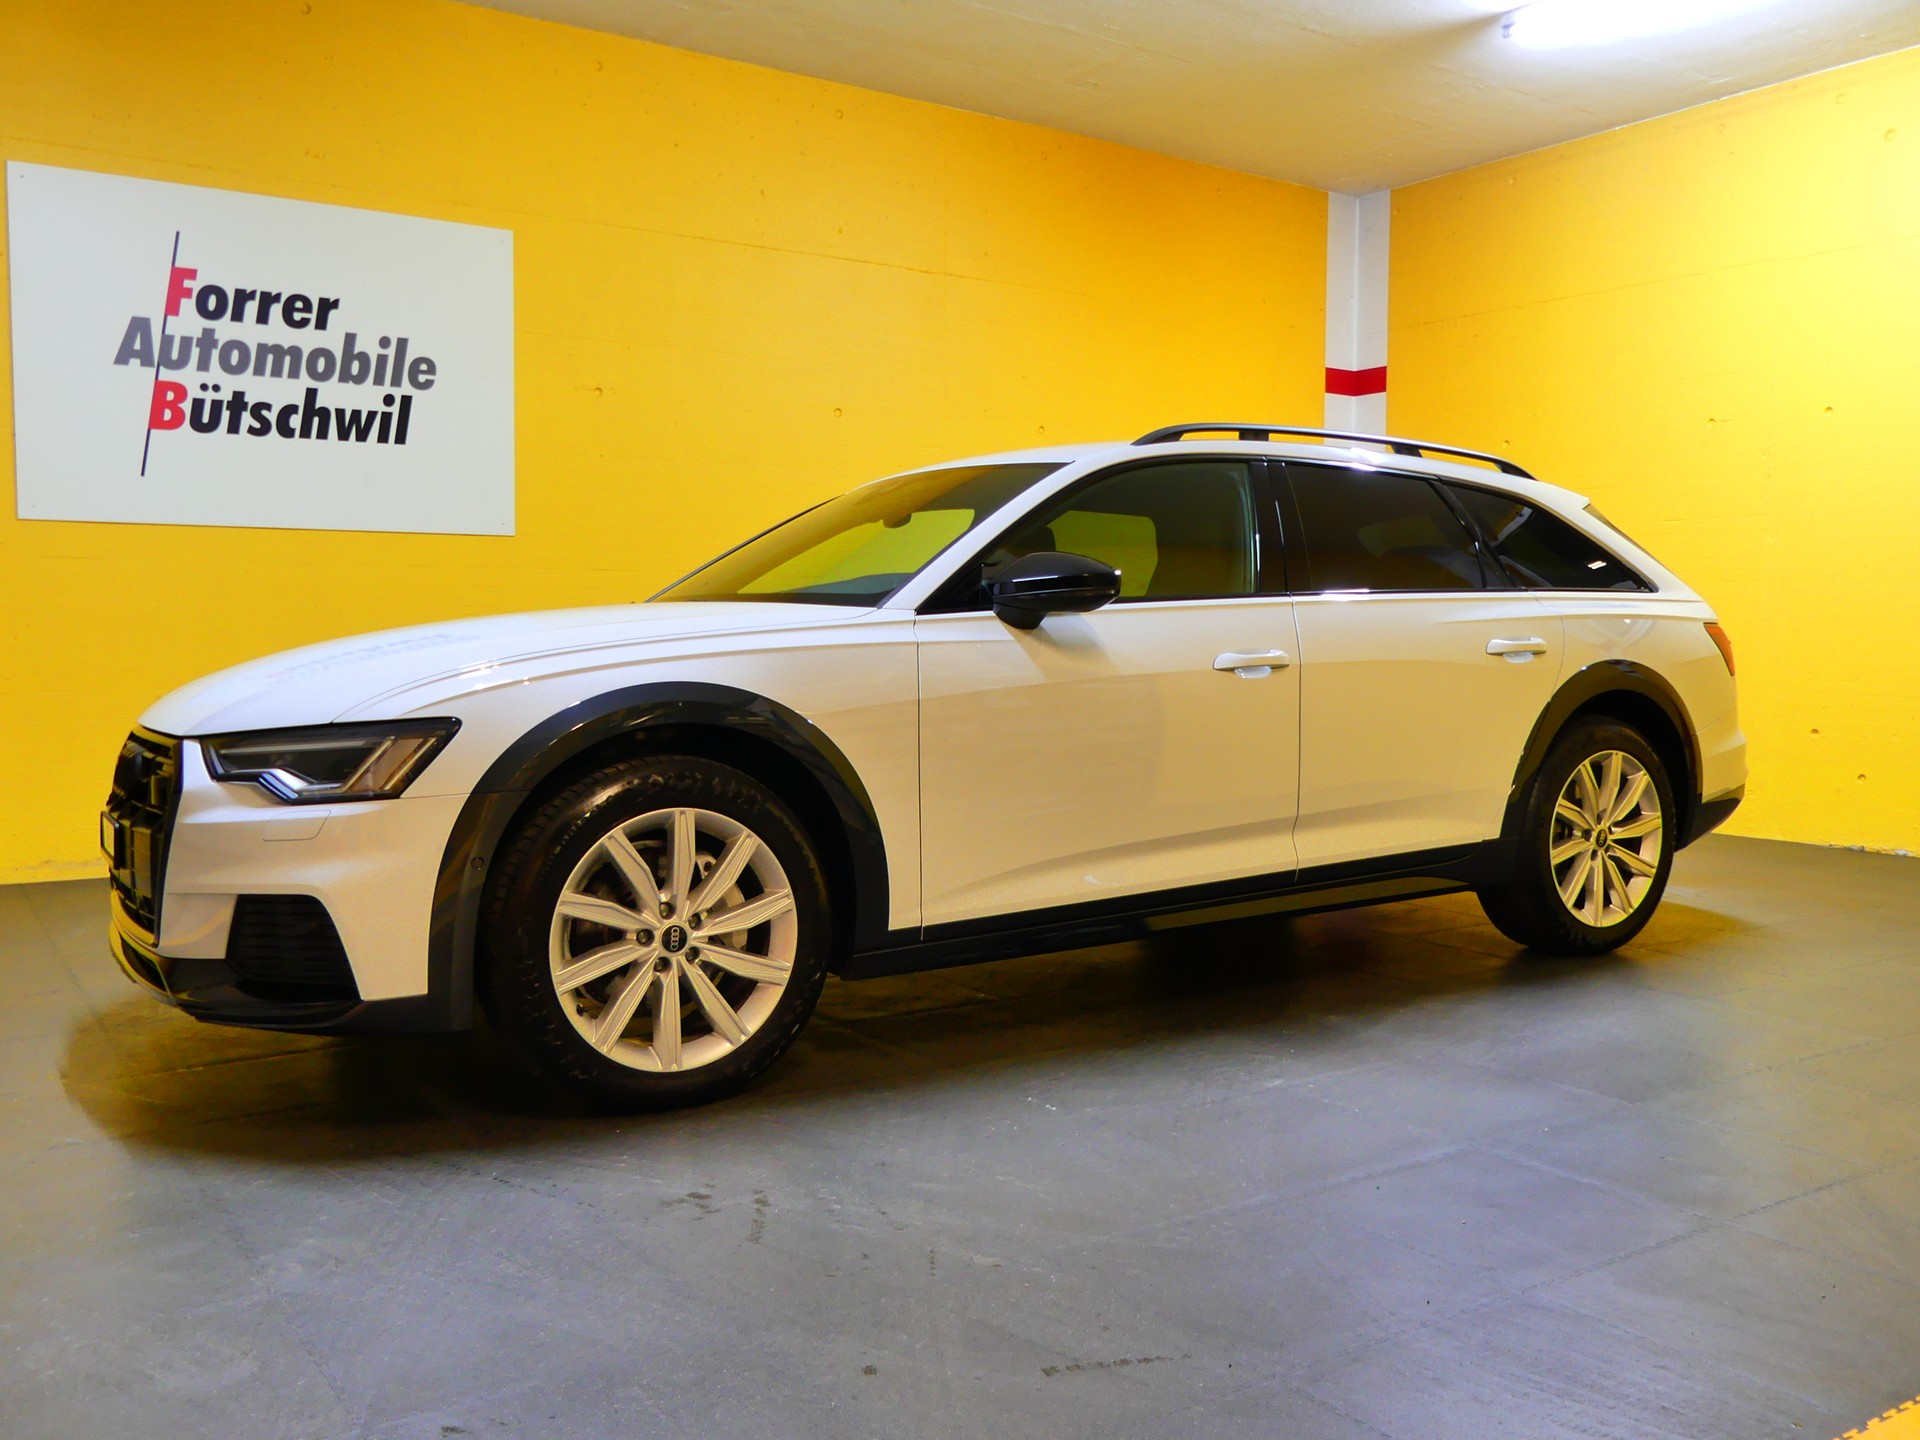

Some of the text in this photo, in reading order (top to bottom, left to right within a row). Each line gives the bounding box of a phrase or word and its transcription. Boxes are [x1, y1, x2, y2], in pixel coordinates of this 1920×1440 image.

[165, 266, 340, 331] Forrer
[113, 316, 437, 390] Automobile
[148, 380, 413, 445] Bütschwil
